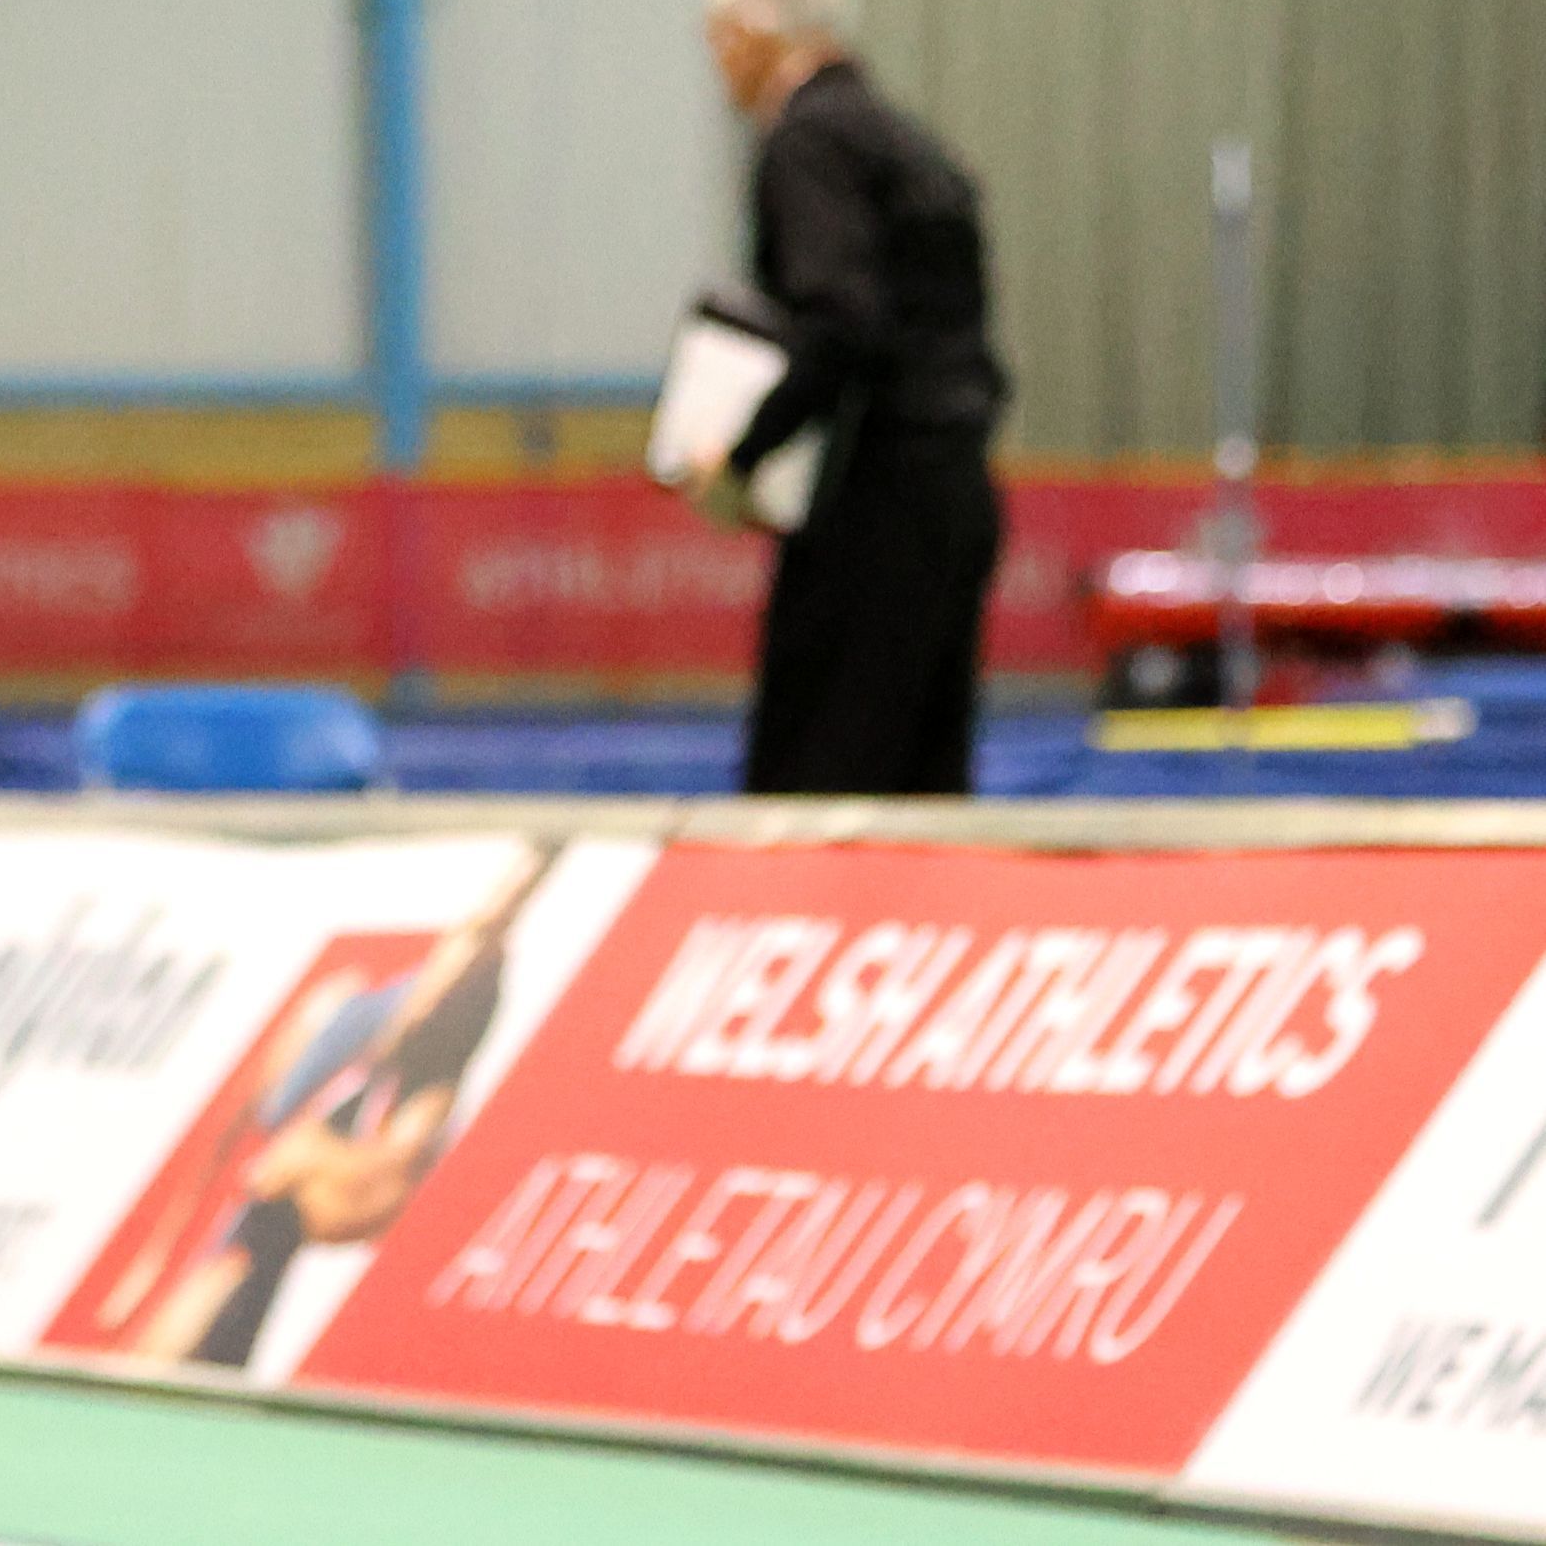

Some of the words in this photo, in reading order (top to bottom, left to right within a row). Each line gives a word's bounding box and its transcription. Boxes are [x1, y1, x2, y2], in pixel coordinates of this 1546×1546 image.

[611, 914, 980, 1088] WELSH
[876, 920, 1424, 1100] ATHLETICS
[421, 1151, 926, 1347] ATHLETAU
[856, 1175, 1242, 1365] CYMRU
